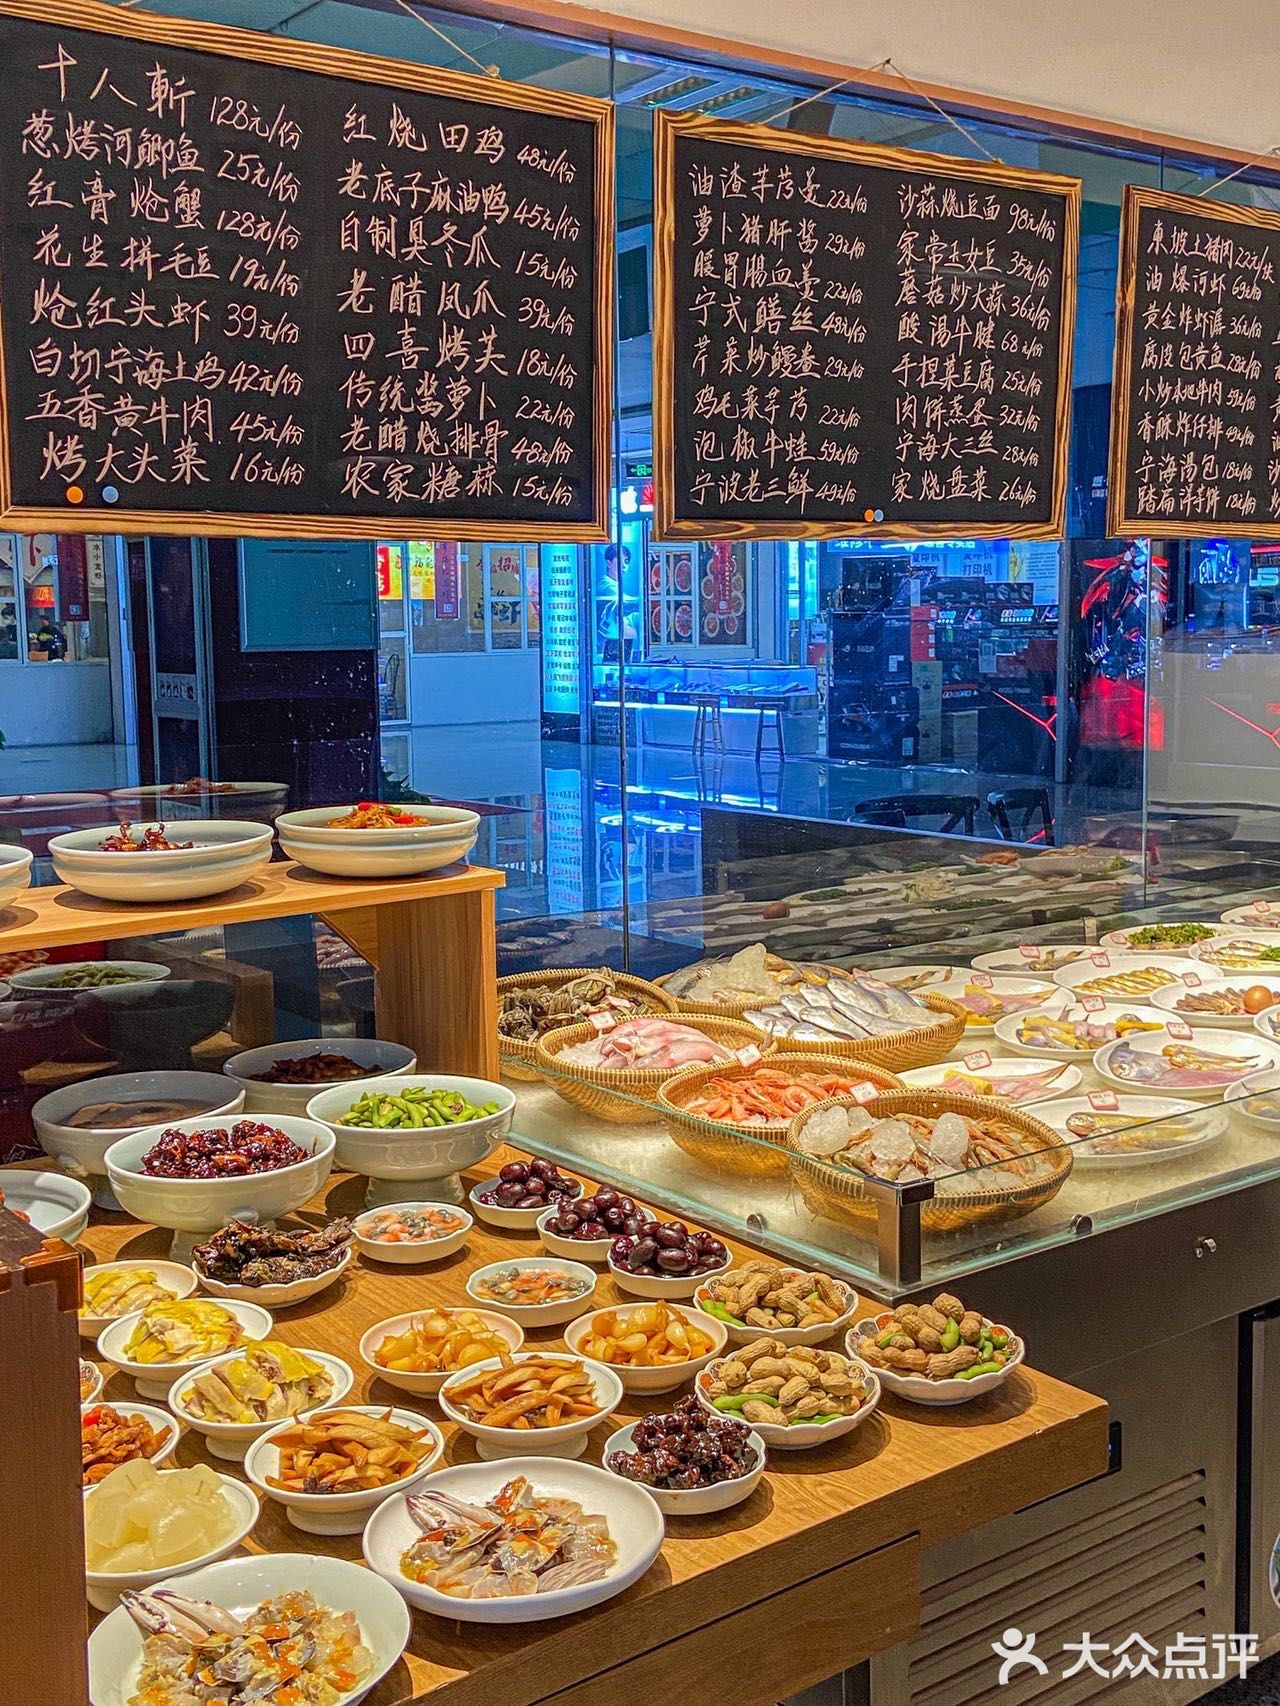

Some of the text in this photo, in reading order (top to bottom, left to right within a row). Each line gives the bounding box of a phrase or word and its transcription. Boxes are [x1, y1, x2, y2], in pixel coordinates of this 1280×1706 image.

[210, 97, 302, 150] 128元/份
[343, 102, 576, 184] 红烧田鸡 48元/份
[217, 150, 301, 203] 25元/份
[337, 158, 581, 242] 老底子麻油鸭 45元/份
[826, 185, 867, 214] 22元/份
[217, 210, 301, 255] 128元/份
[1007, 203, 1057, 242] 98元/份
[33, 224, 300, 297] 花生拼毛豆 19元/份
[825, 233, 865, 260] 29元/份
[515, 251, 577, 289] 15元/份
[1007, 251, 1052, 293] 35元/份
[823, 281, 864, 305] 22元/份
[224, 303, 299, 343] 39元/份
[518, 297, 575, 336] 39元/份
[1010, 295, 1051, 331] 36元/份
[1001, 329, 1044, 358] 68元/份
[228, 360, 303, 396] 42元/份
[517, 349, 577, 389] 18元/份
[824, 356, 865, 382] 29元/份
[1002, 370, 1042, 397] 25元/份
[25, 384, 304, 447] 五香黄牛肉 45元/份
[515, 396, 575, 429] 22元/份
[818, 405, 861, 431] 22元/份
[999, 404, 1041, 433] 32元/份
[40, 431, 305, 484] 烤大头菜 16元/份
[510, 436, 573, 465] 48元/份
[693, 424, 860, 469] 泡椒牛蛙 59元/份
[1002, 445, 1040, 468] 28元/份
[340, 456, 572, 506] 农家糖蒜 15元/份
[815, 481, 857, 505] 49元/份
[999, 476, 1037, 508] 26元/份
